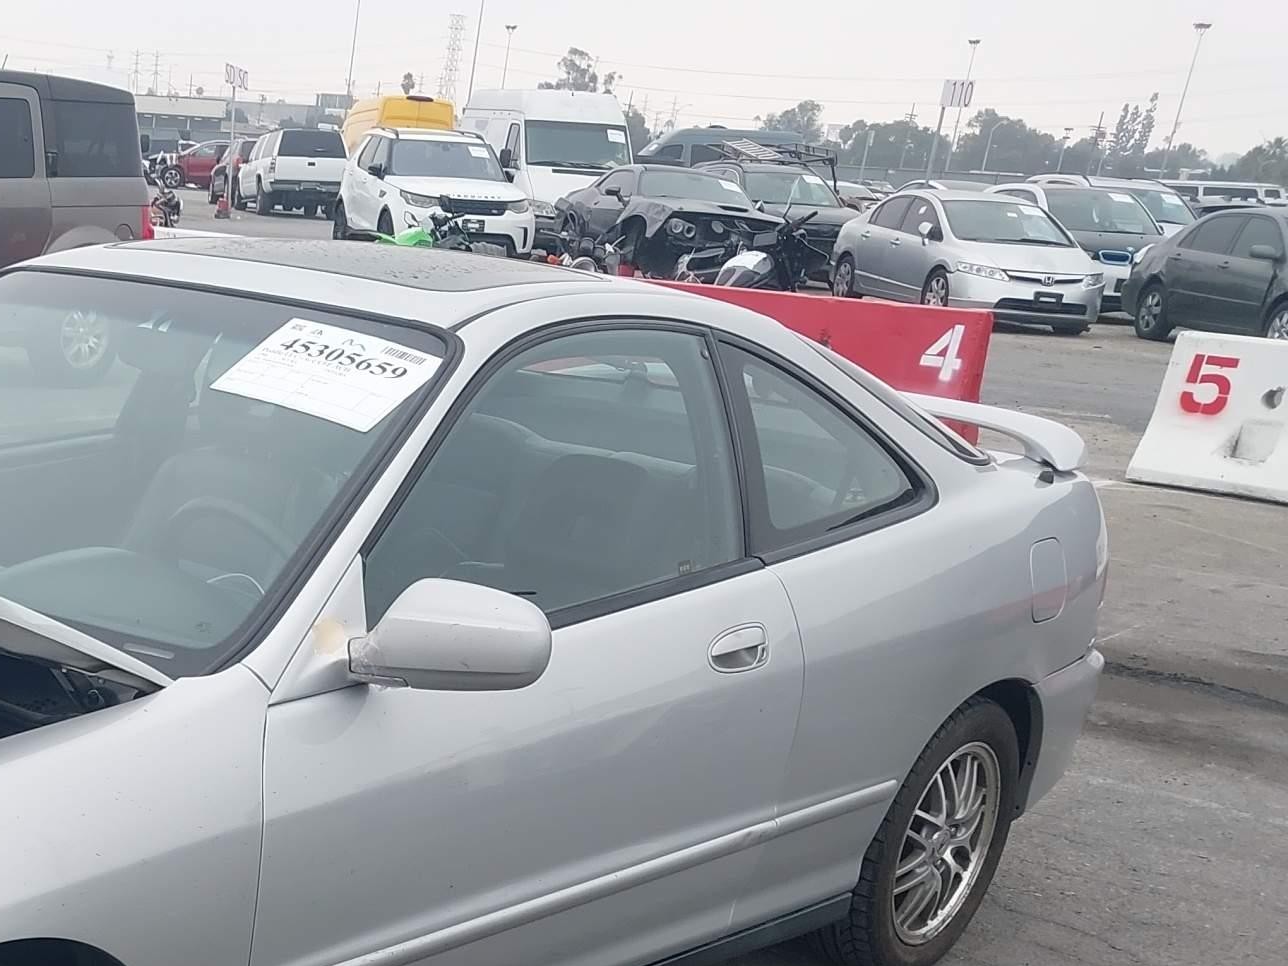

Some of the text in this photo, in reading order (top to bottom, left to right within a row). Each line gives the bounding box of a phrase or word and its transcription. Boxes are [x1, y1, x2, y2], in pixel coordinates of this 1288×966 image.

[950, 80, 974, 108] 110
[279, 337, 409, 379] 45305659
[919, 324, 966, 382] 4
[1179, 354, 1241, 415] 5
